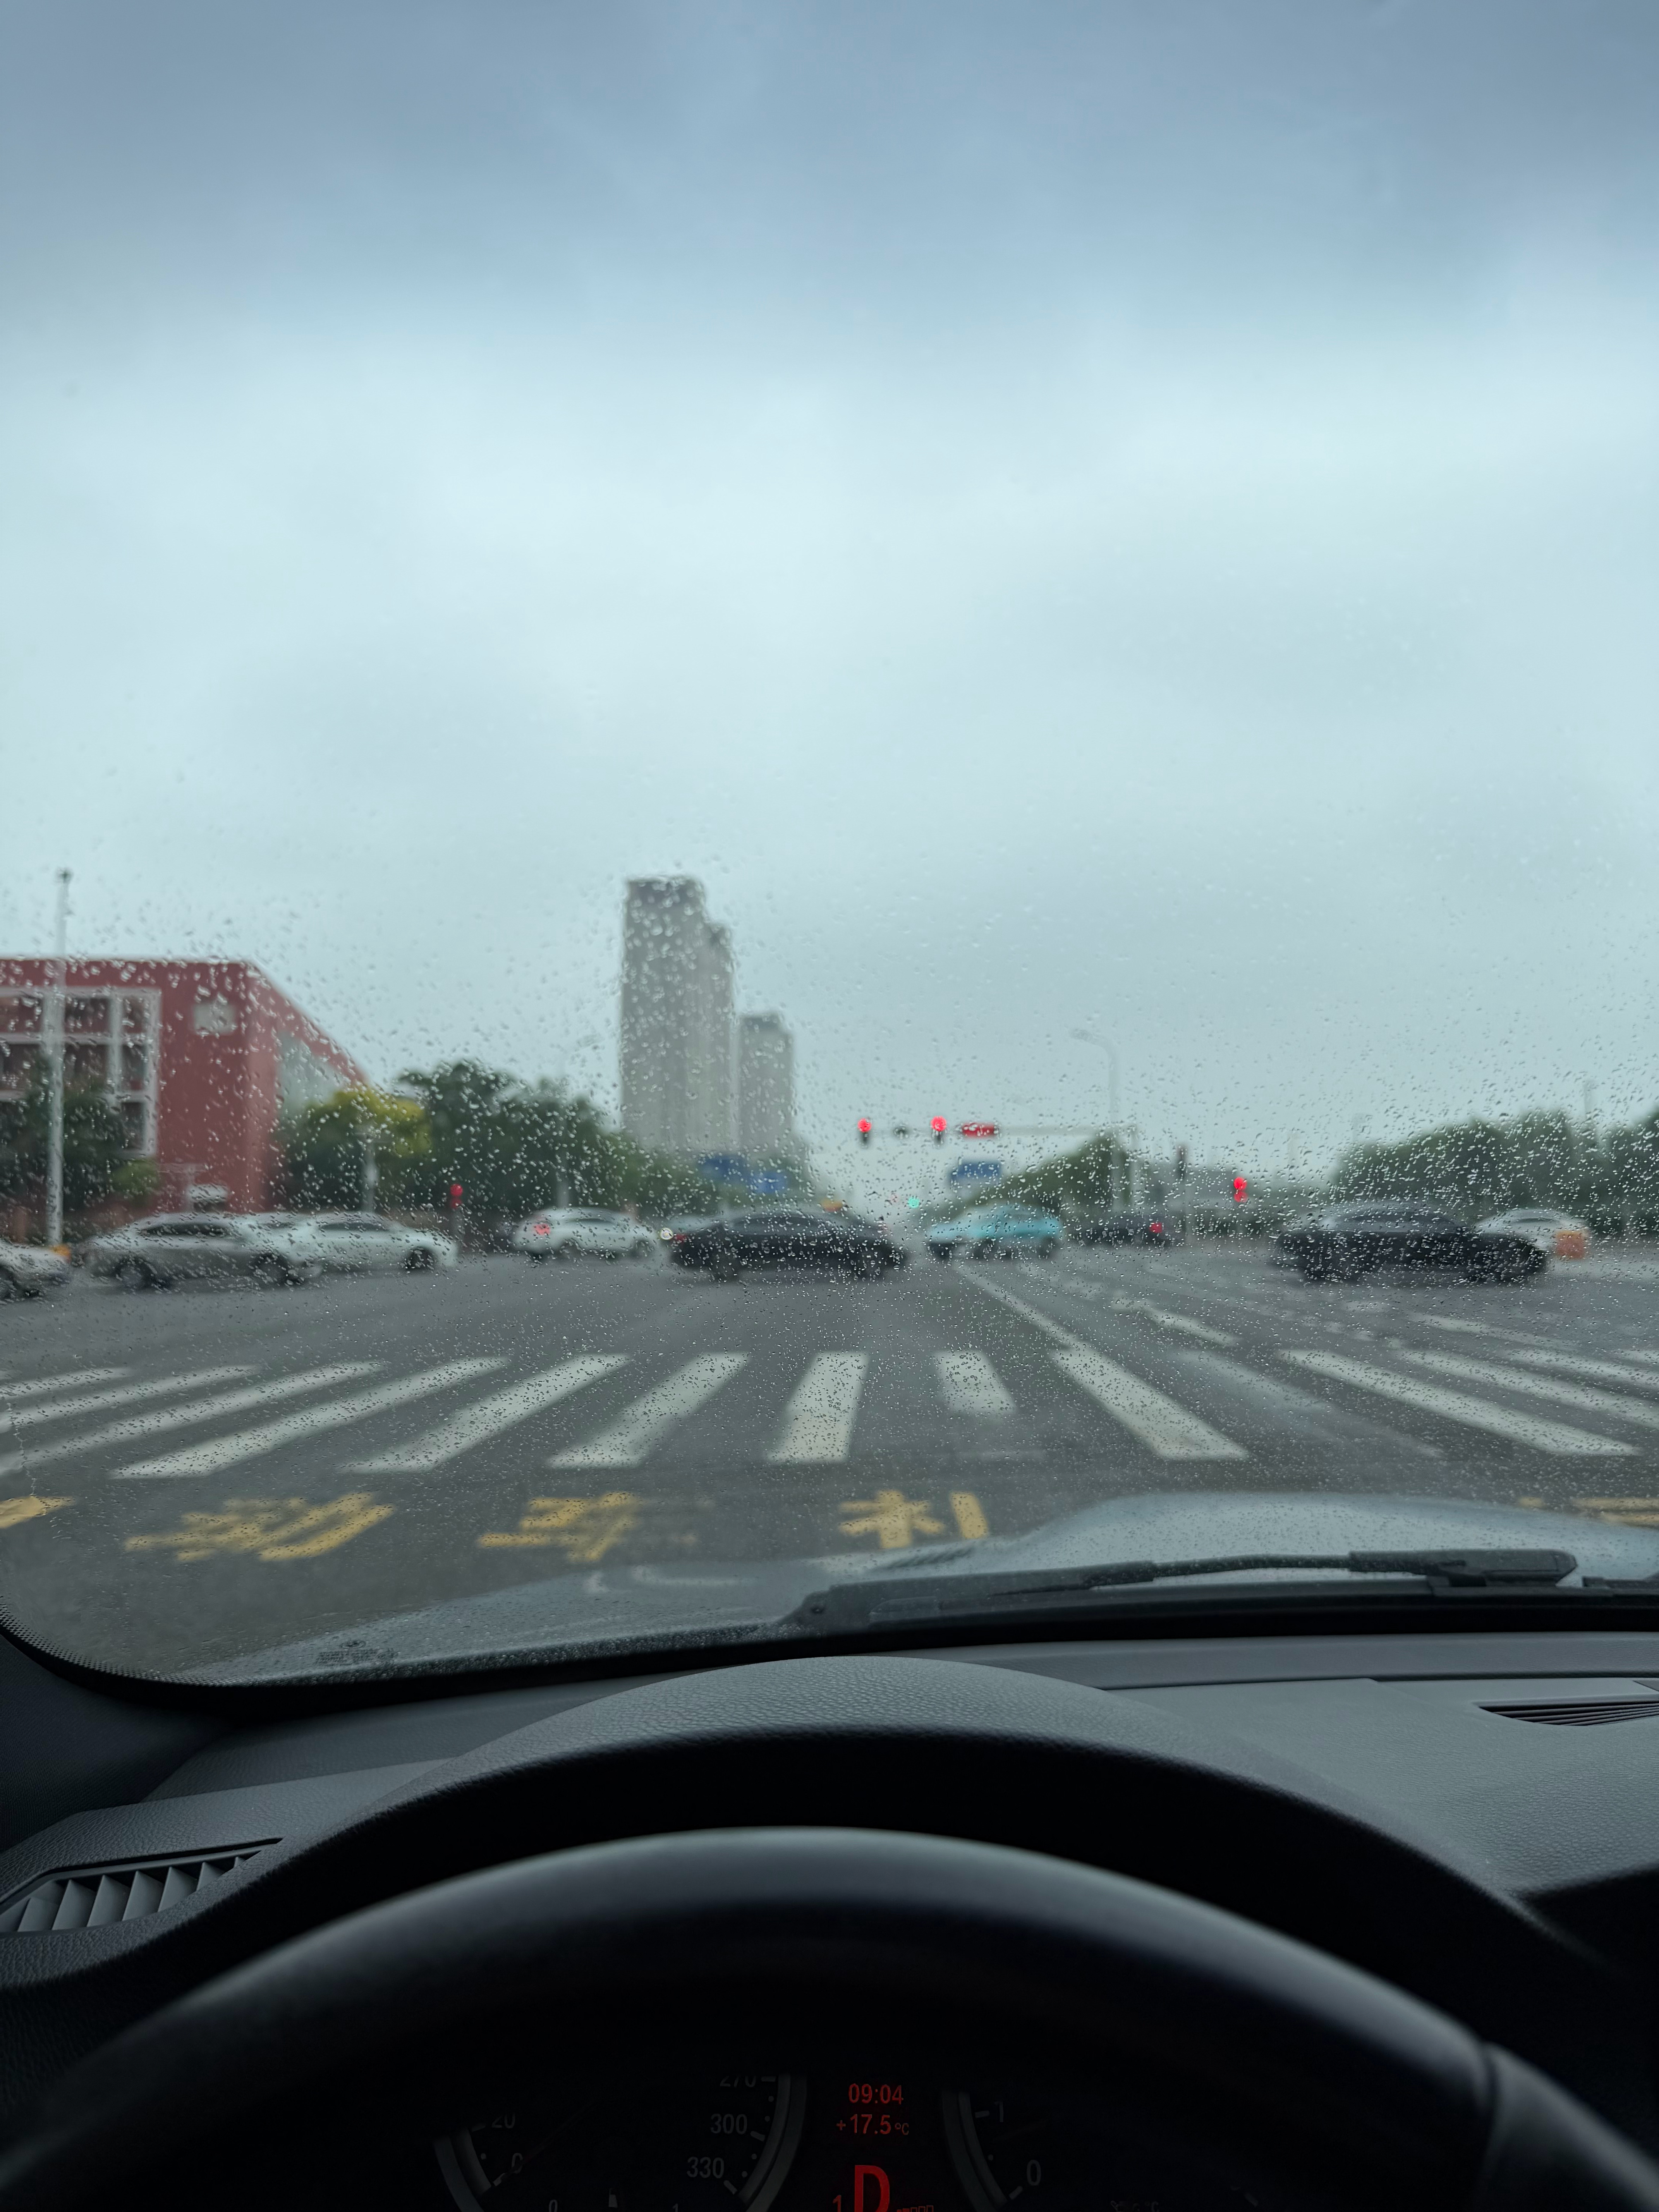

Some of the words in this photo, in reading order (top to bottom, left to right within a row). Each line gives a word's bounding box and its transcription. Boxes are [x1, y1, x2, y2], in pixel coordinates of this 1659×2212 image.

[848, 2083, 904, 2105] 09:04
[994, 2100, 1004, 2123] 1
[710, 2113, 748, 2135] 300
[686, 2156, 725, 2179] 330
[1026, 2159, 1042, 2186] 0
[854, 2164, 890, 2212] D
